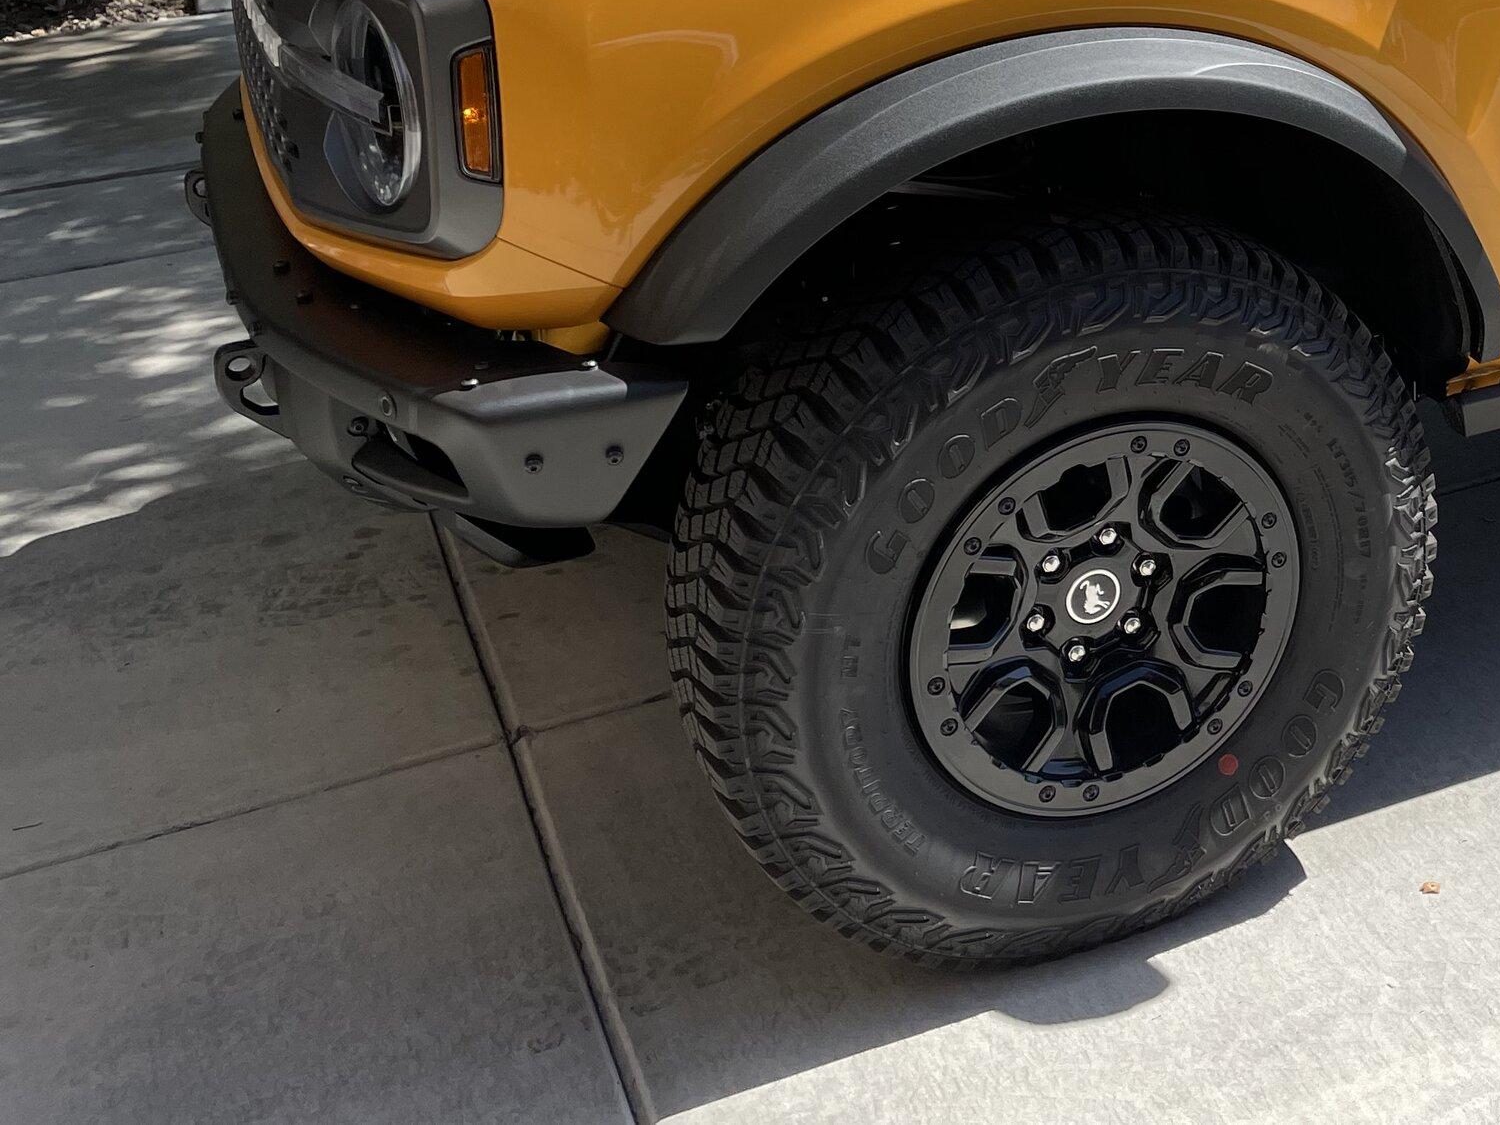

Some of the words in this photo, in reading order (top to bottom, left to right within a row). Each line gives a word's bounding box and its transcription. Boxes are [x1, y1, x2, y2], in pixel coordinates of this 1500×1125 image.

[865, 345, 1276, 575] GOODYEAR
[839, 707, 928, 857] TERRITORY
[958, 667, 1346, 905] GOODYEAR
